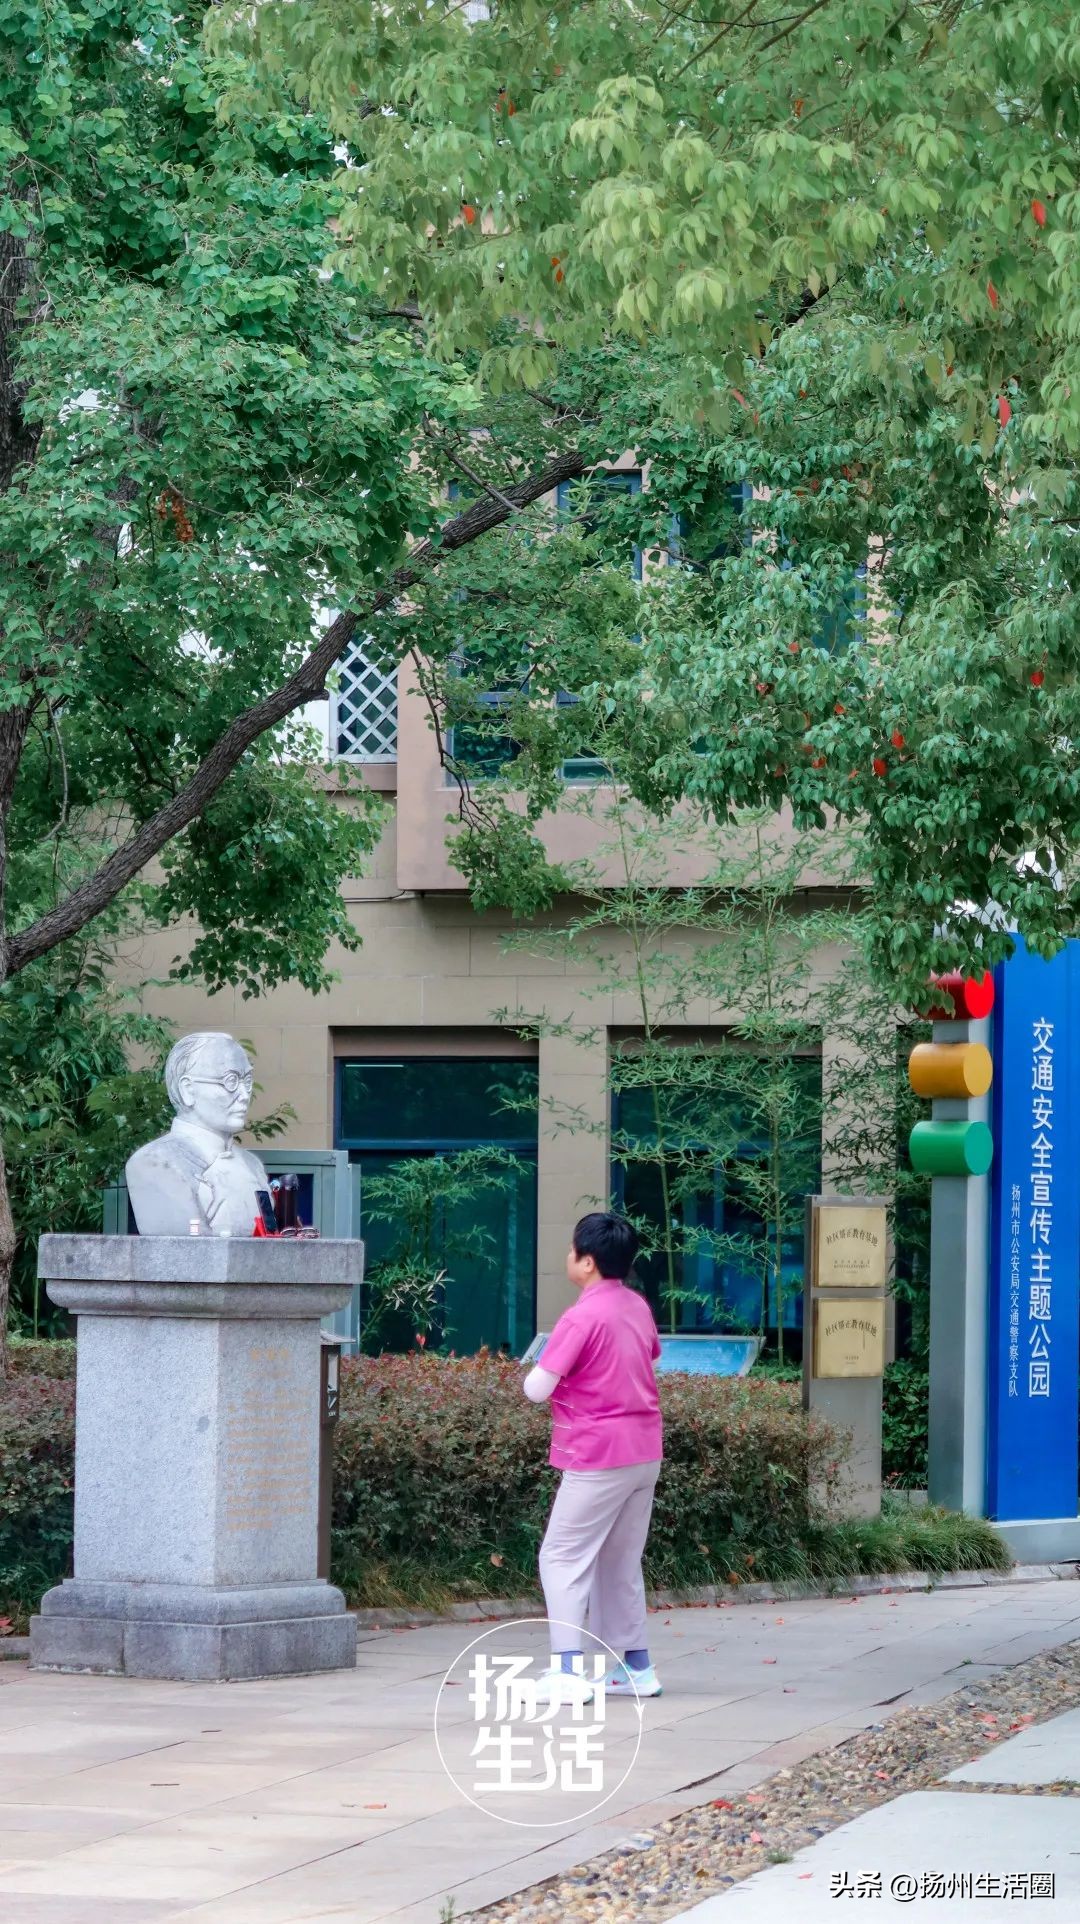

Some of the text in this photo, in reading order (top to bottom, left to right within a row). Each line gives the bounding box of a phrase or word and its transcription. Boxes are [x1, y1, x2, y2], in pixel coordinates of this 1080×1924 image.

[1008, 1184, 1021, 1397] 扬州市公安局交通警察支队
[1028, 1017, 1055, 1398] 交通安全宣传主题公园
